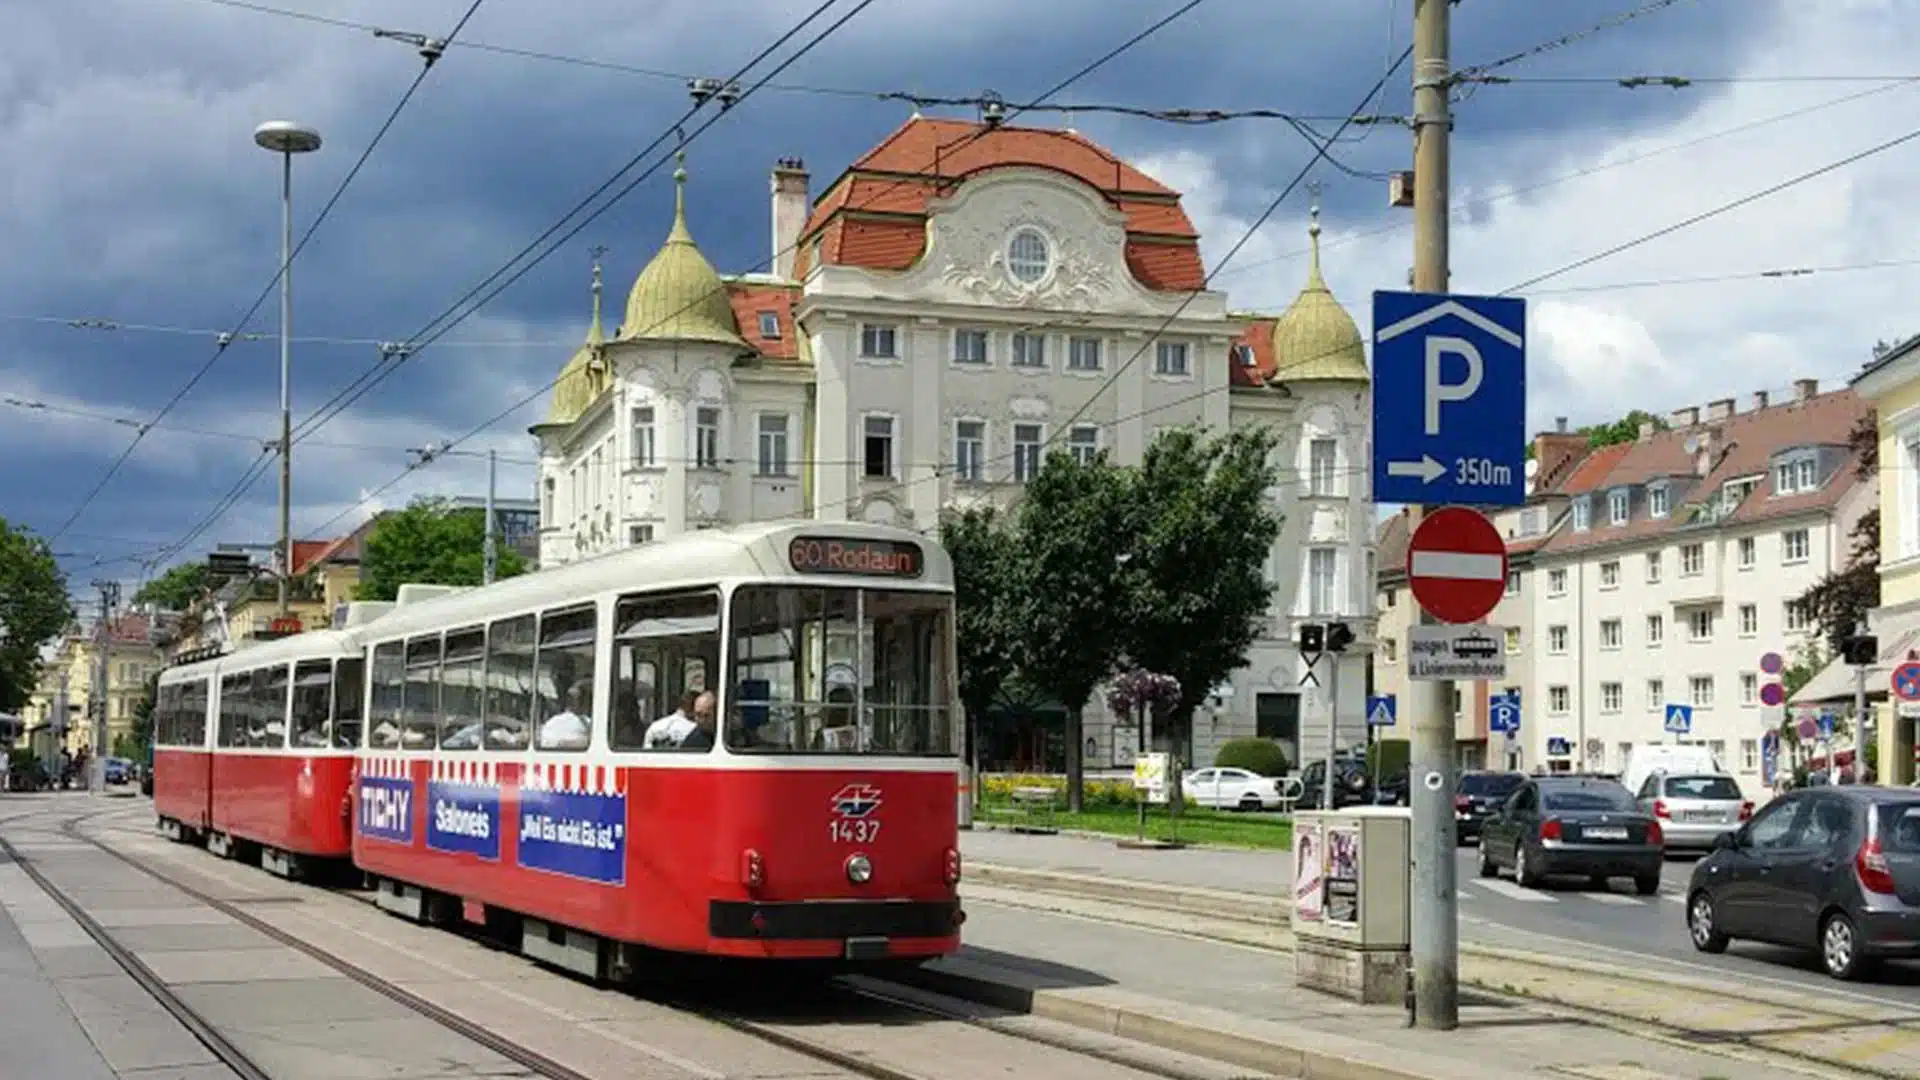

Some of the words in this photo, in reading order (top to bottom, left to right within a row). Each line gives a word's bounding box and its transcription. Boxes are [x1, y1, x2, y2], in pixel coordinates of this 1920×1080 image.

[1425, 336, 1484, 435] P
[1456, 458, 1512, 486] 350m
[791, 539, 821, 567] 60
[827, 543, 912, 572] Rodaun
[361, 786, 410, 833] TICHY
[830, 819, 880, 843] 1437
